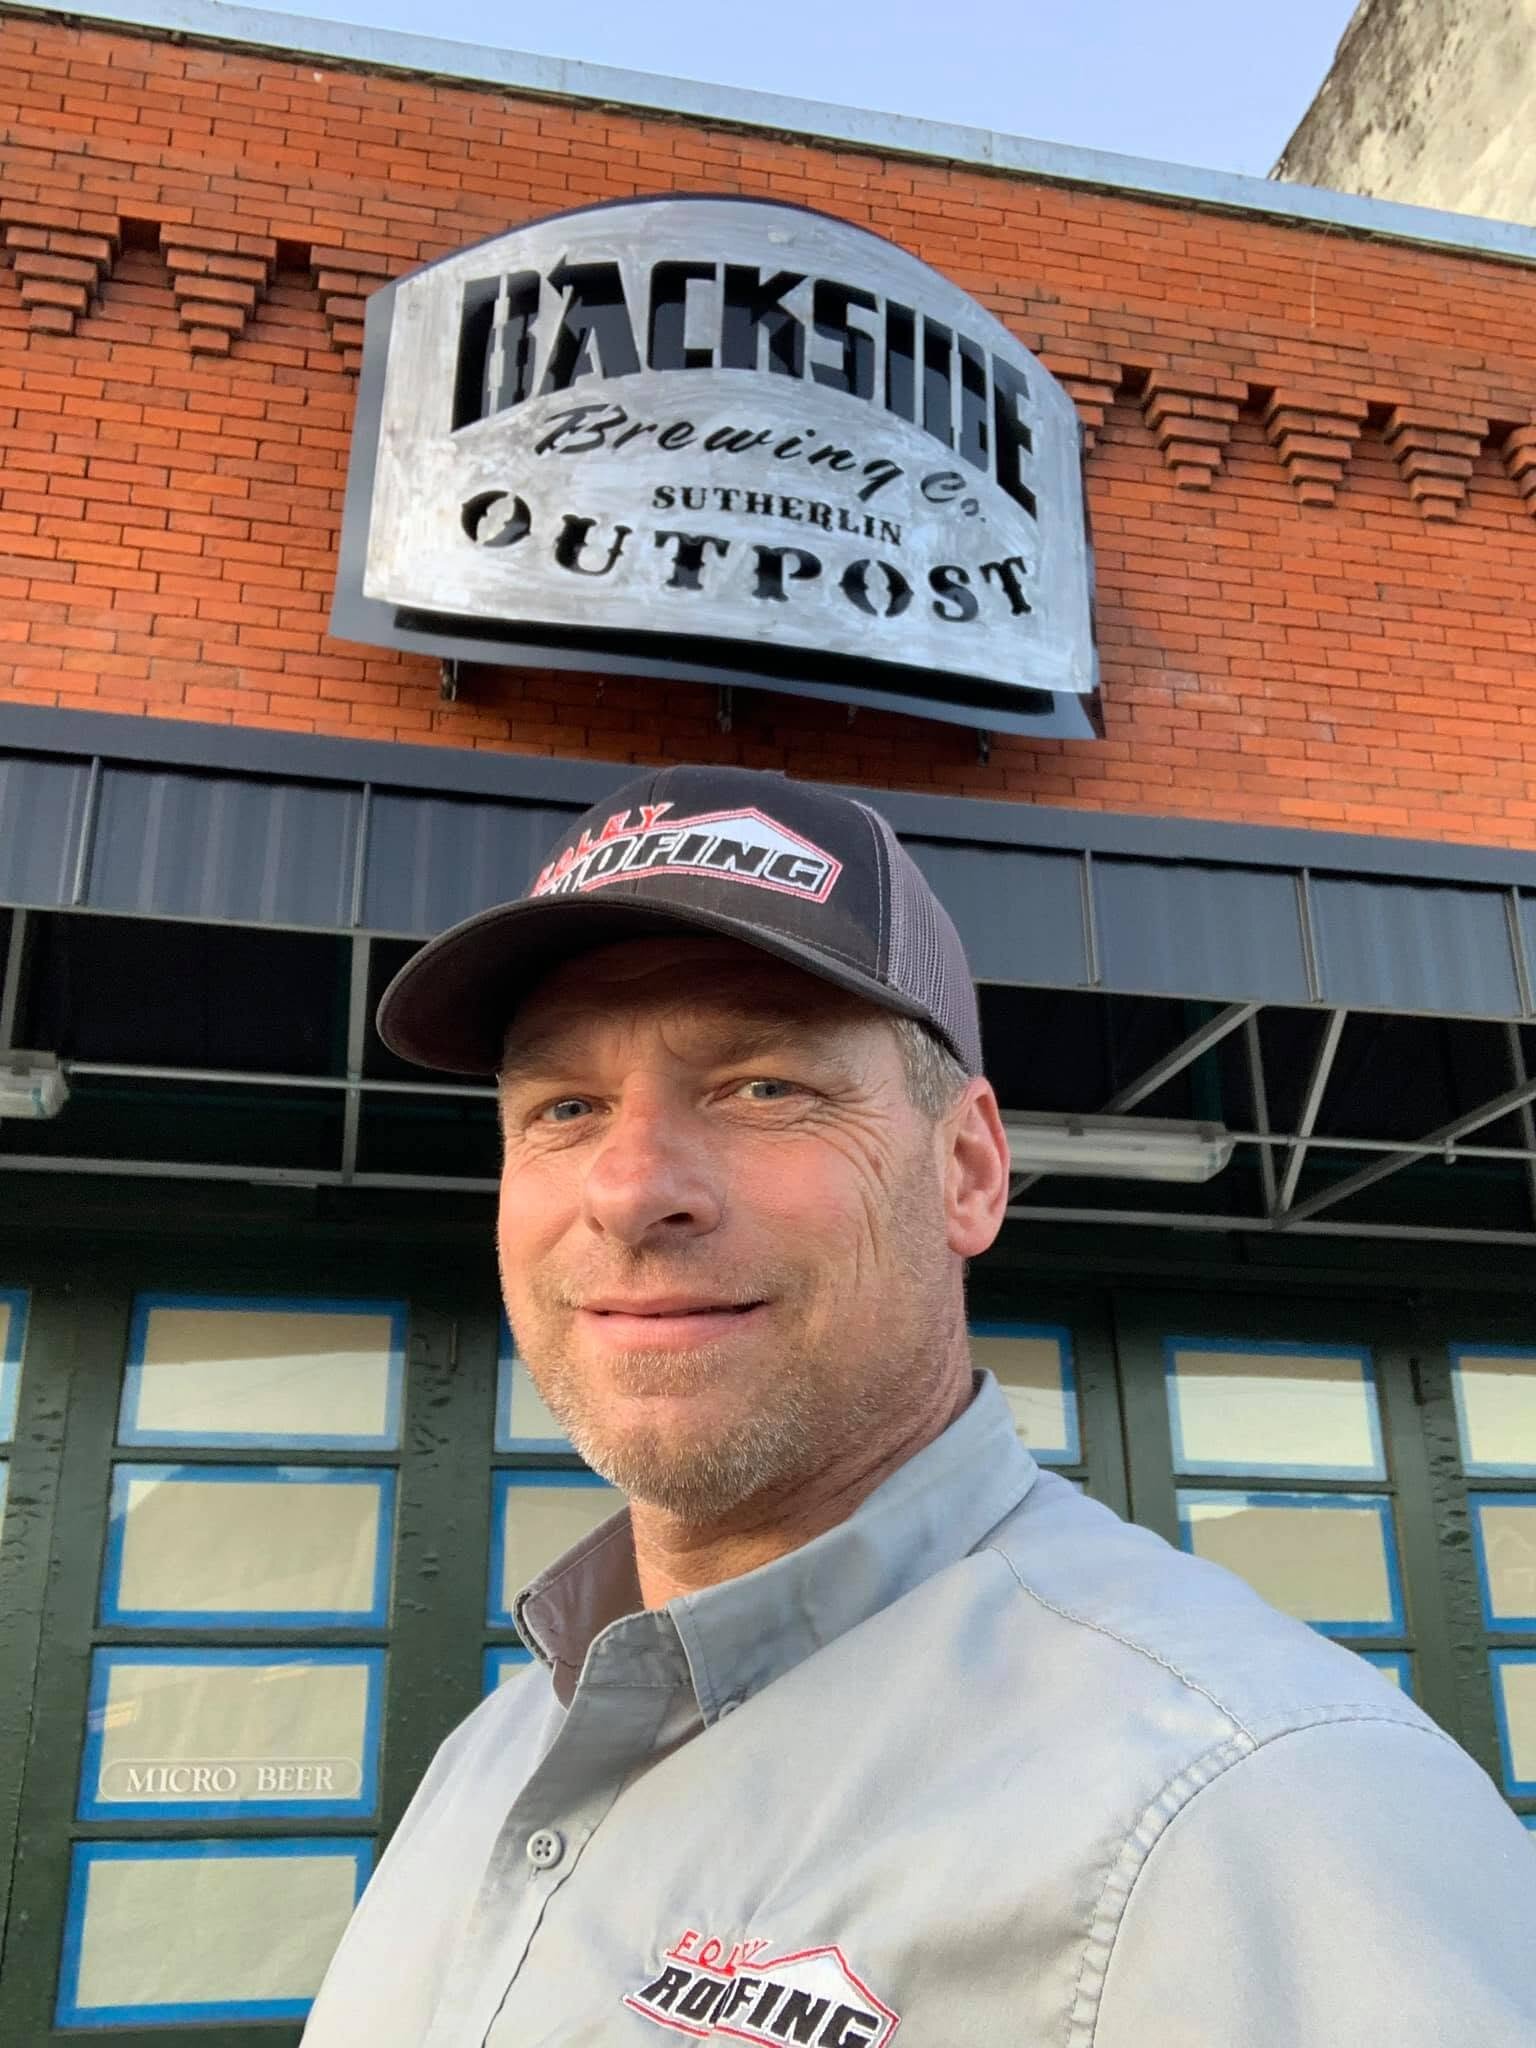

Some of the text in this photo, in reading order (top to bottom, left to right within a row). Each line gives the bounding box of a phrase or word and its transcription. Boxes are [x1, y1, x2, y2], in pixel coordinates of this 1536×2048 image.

[452, 254, 1037, 520] BACKSIDE
[535, 404, 904, 499] Brewing
[461, 490, 1032, 623] OUTPOST
[652, 484, 902, 546] SUTHERLIN
[126, 1766, 335, 1793] MICRO BEER
[636, 1965, 882, 2048] ROFING
